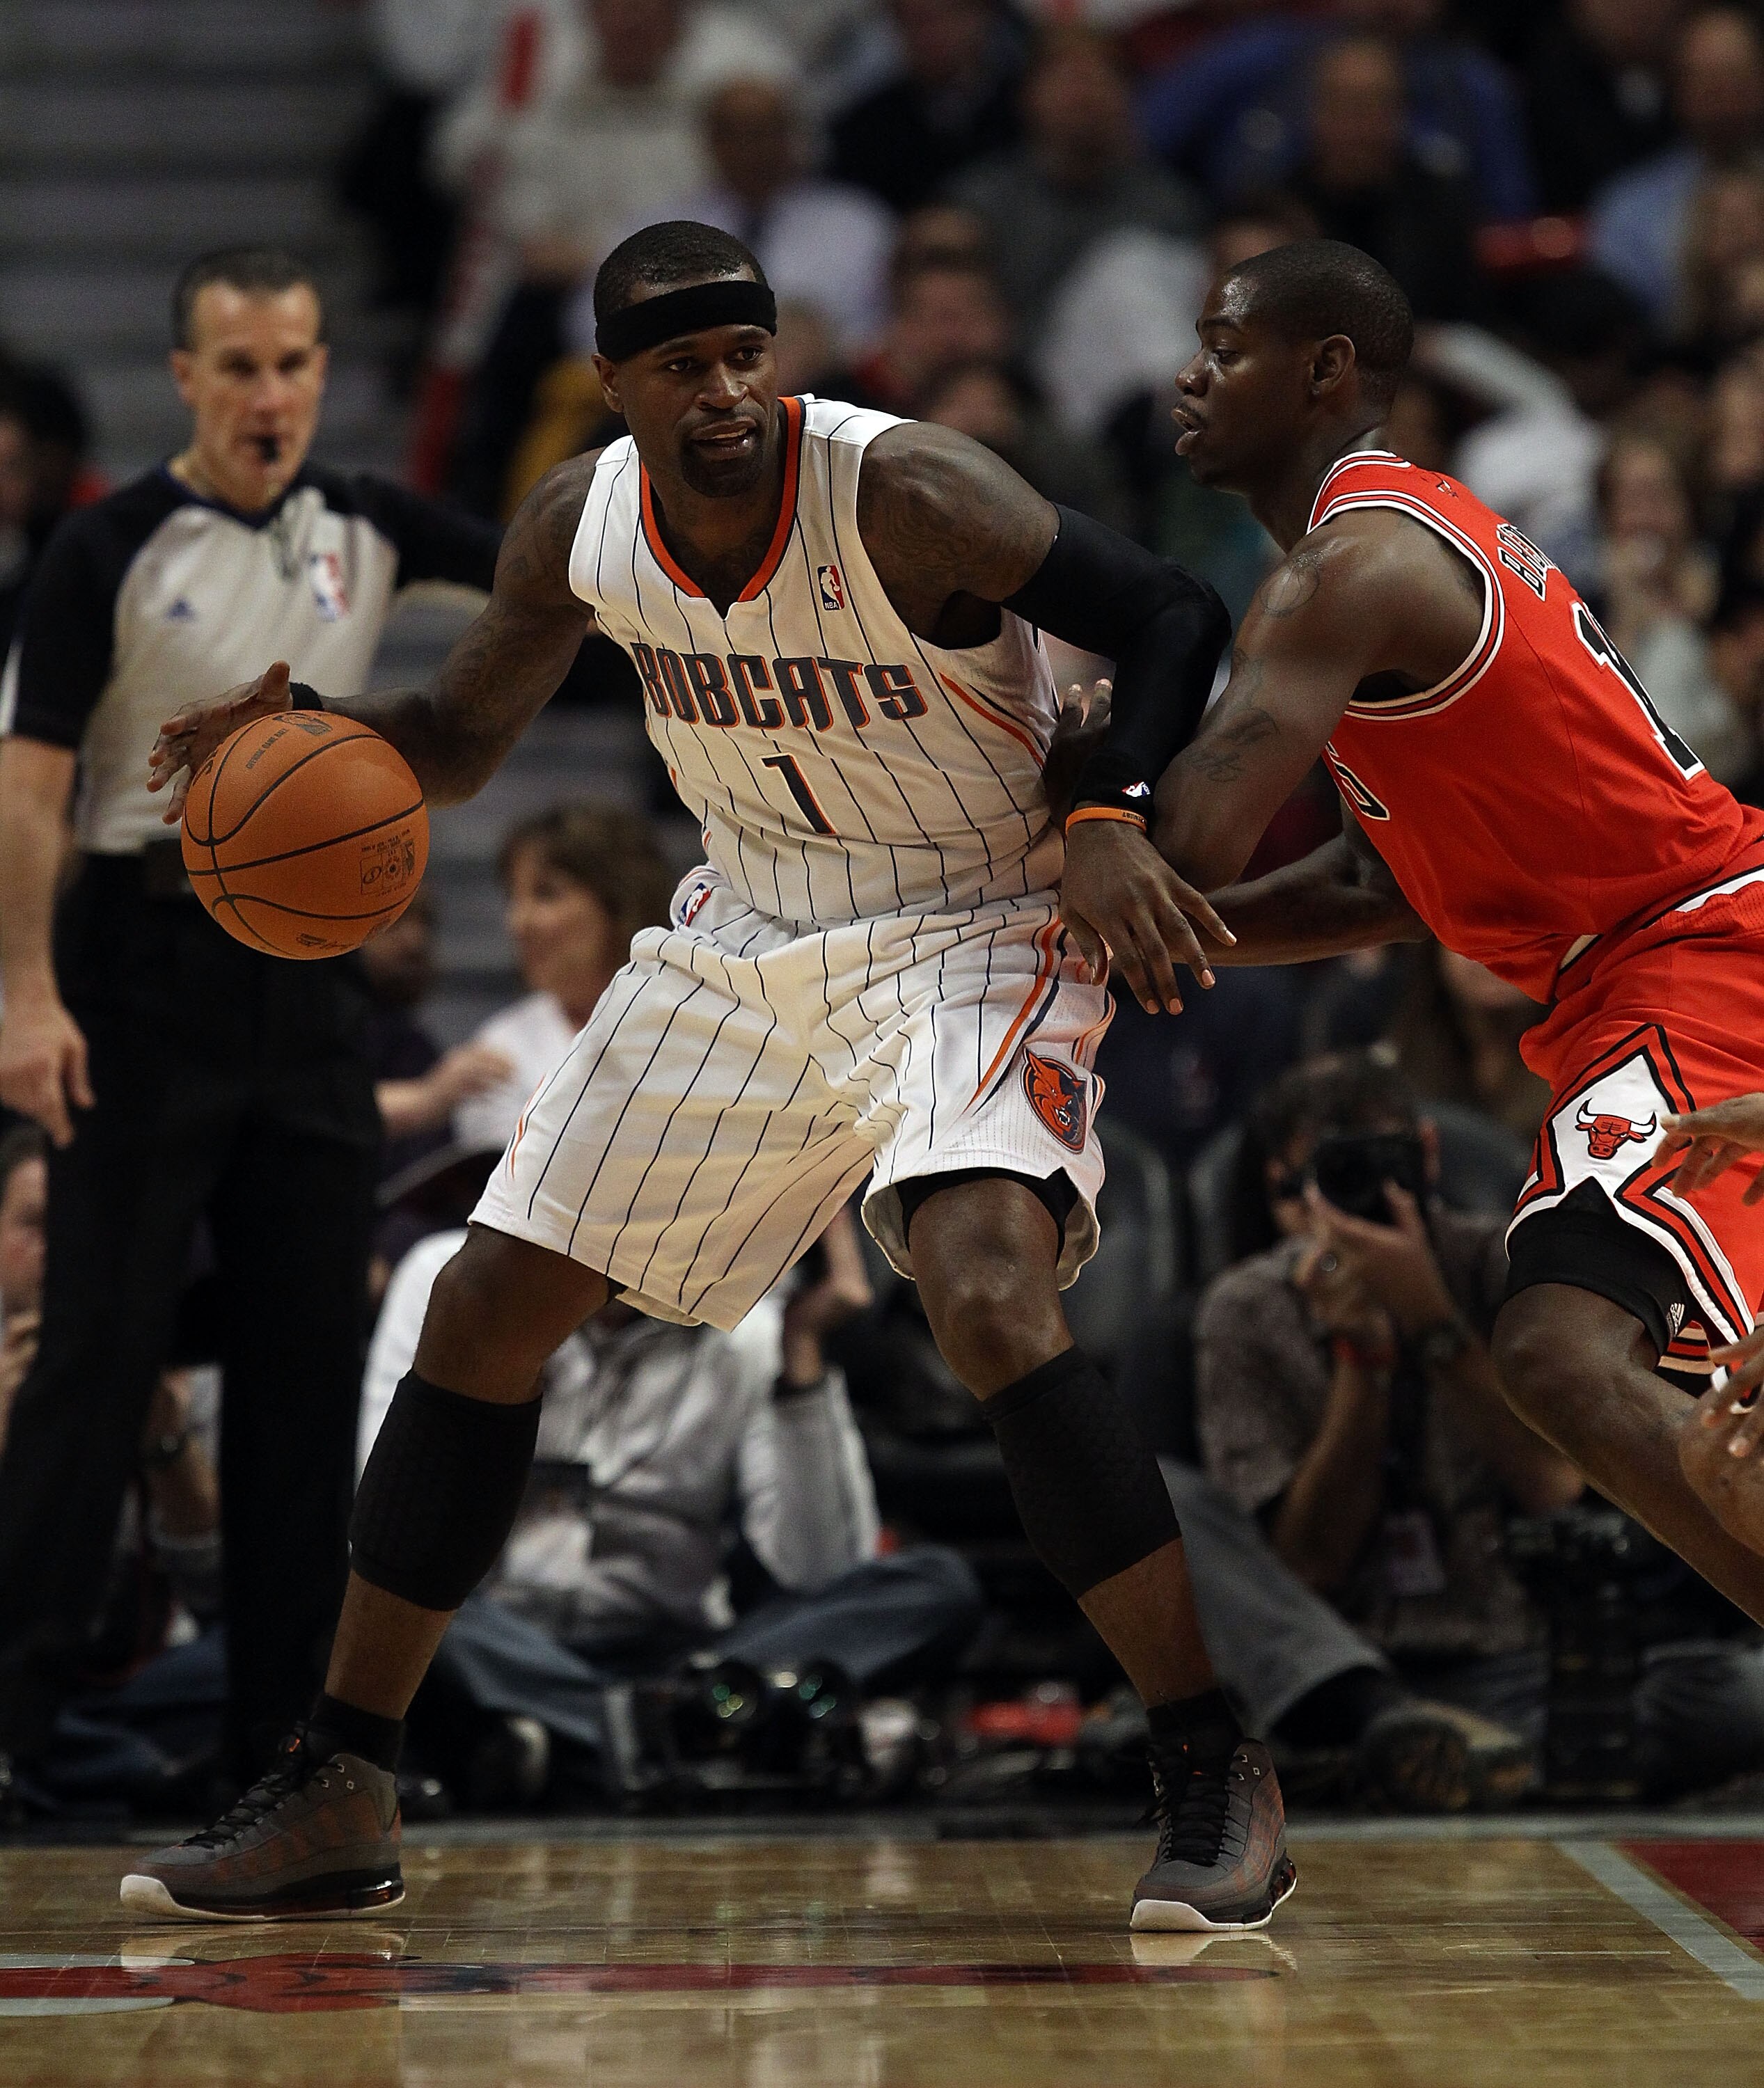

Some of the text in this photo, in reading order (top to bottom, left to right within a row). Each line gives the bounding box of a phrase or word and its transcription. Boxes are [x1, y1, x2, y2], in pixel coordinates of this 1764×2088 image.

[824, 601, 839, 610] NBA
[630, 642, 927, 732] BOBCATS
[262, 736, 278, 749] GAME
[274, 728, 290, 738] BALL
[757, 754, 835, 835] 1
